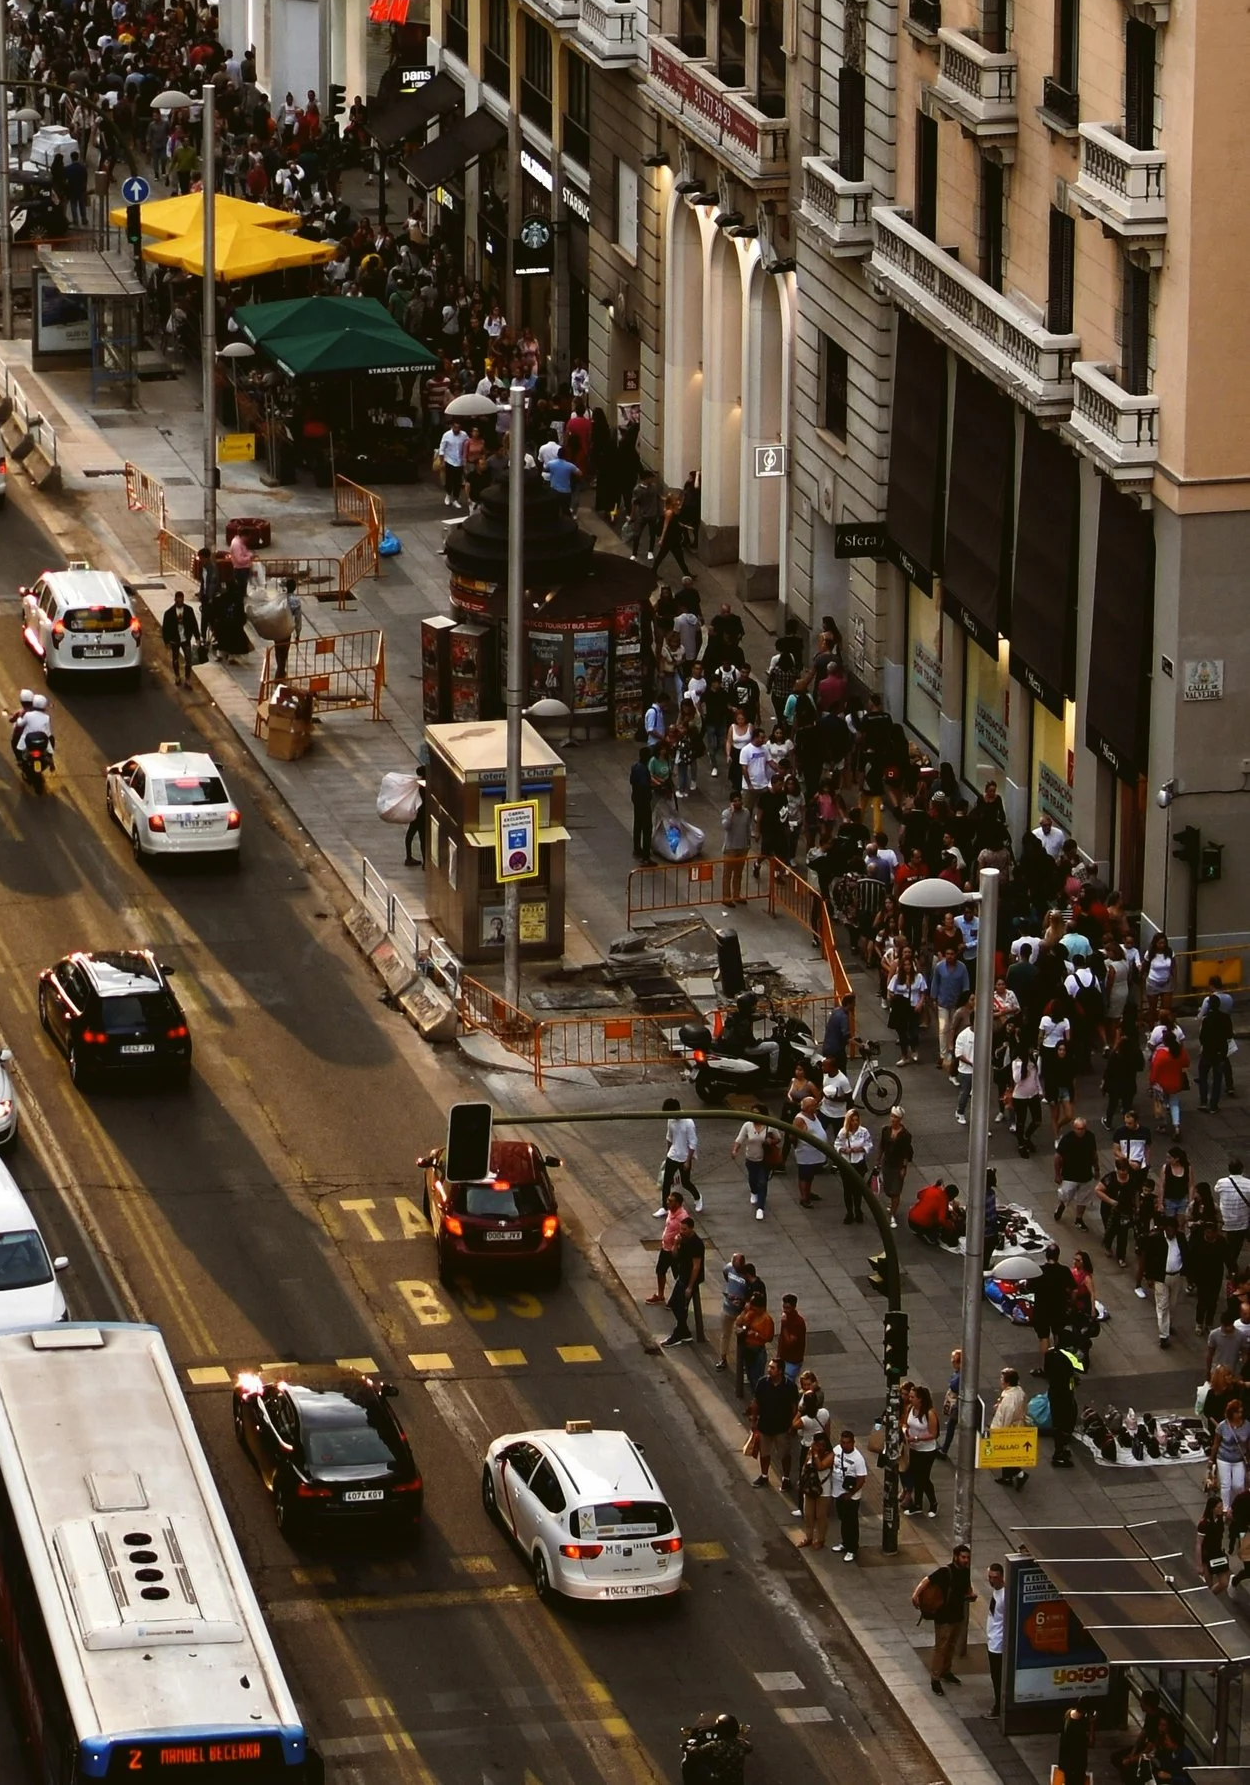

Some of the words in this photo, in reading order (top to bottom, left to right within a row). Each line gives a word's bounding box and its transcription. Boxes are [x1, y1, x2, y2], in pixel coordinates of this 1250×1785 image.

[402, 71, 431, 84] pans
[369, 366, 409, 374] STARBUCKS
[545, 622, 571, 630] TOURIST
[1185, 690, 1222, 699] VALVERDE
[1053, 1666, 1108, 1685] yoigo
[128, 1749, 142, 1770] 2
[160, 1747, 205, 1765] MANUEL
[209, 1742, 261, 1762] BECERRA
